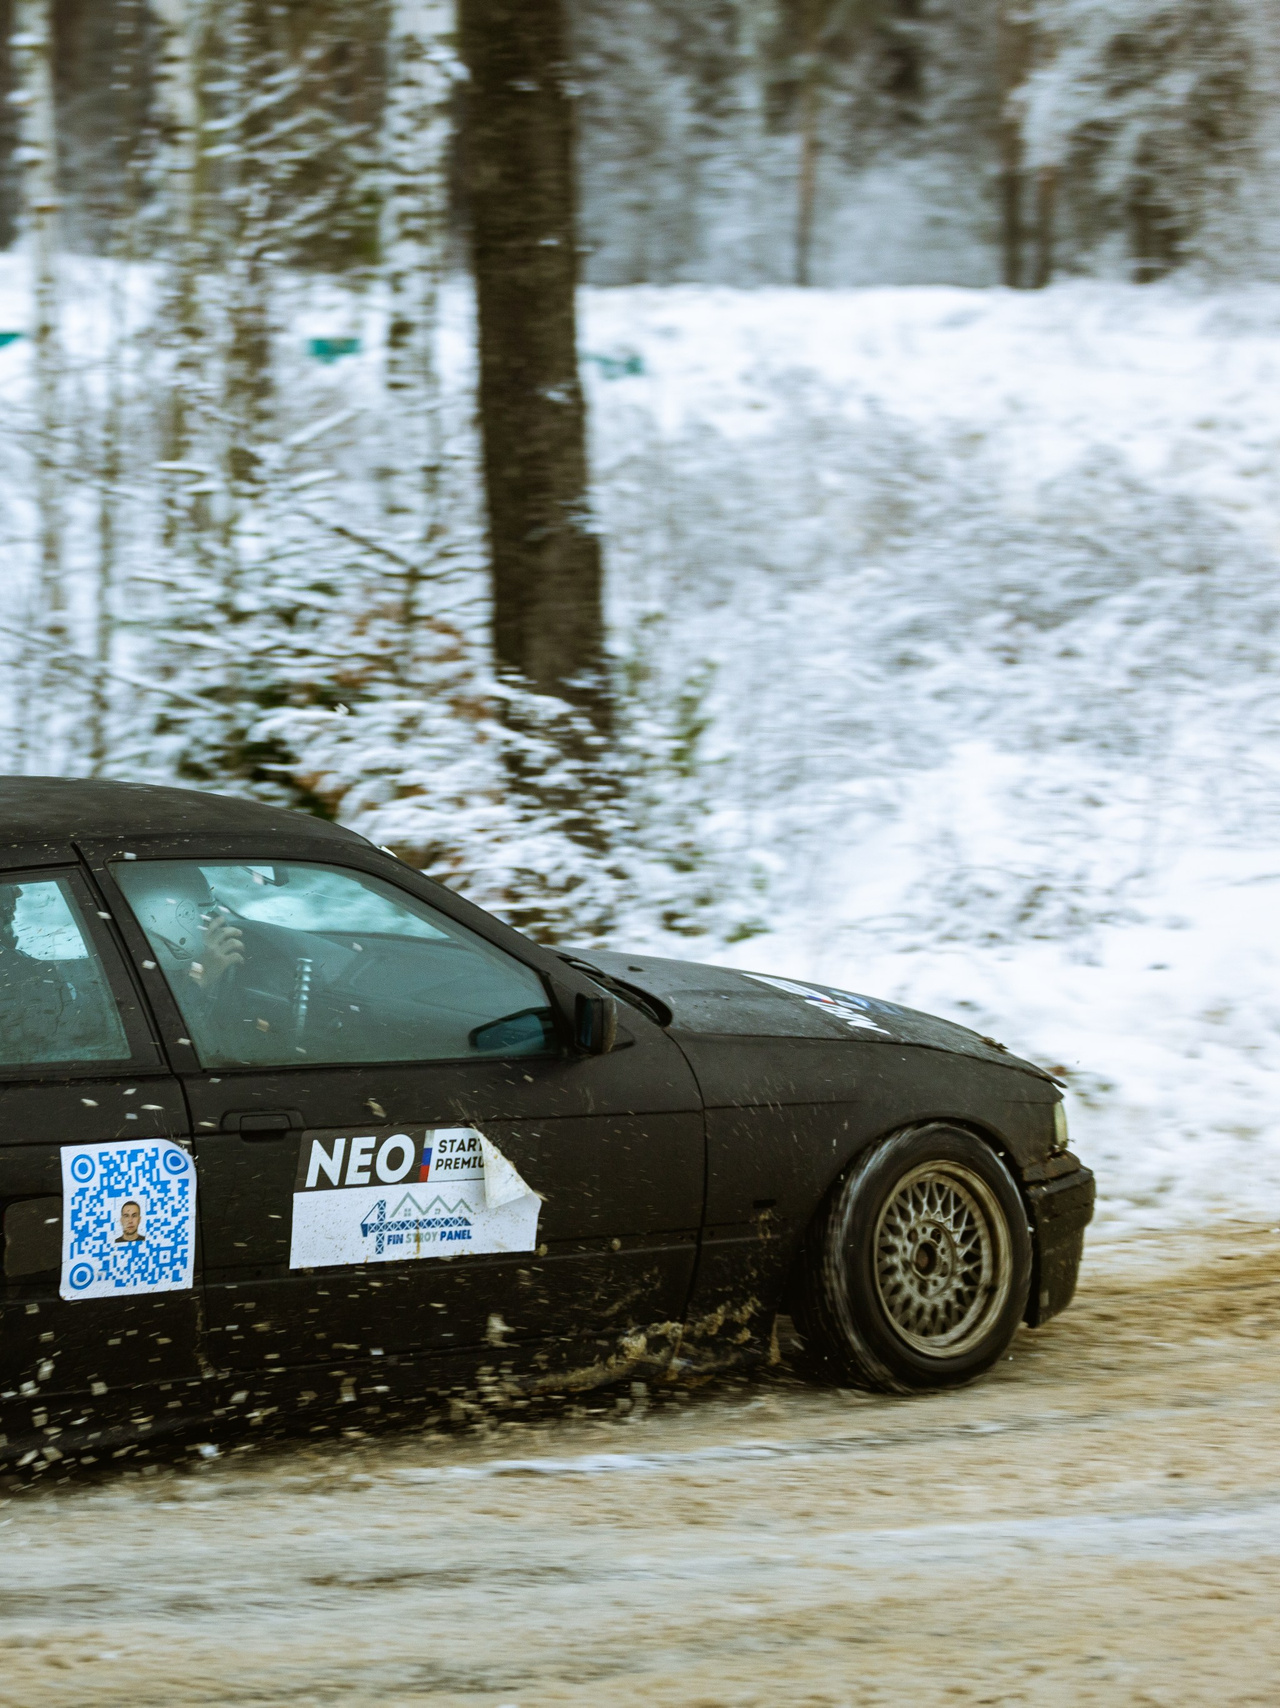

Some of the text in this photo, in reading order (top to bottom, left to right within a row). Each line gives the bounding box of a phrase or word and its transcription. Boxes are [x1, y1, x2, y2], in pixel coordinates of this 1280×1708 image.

[305, 1134, 416, 1188] NEO
[387, 1230, 473, 1245] FIN STROY PANEL
